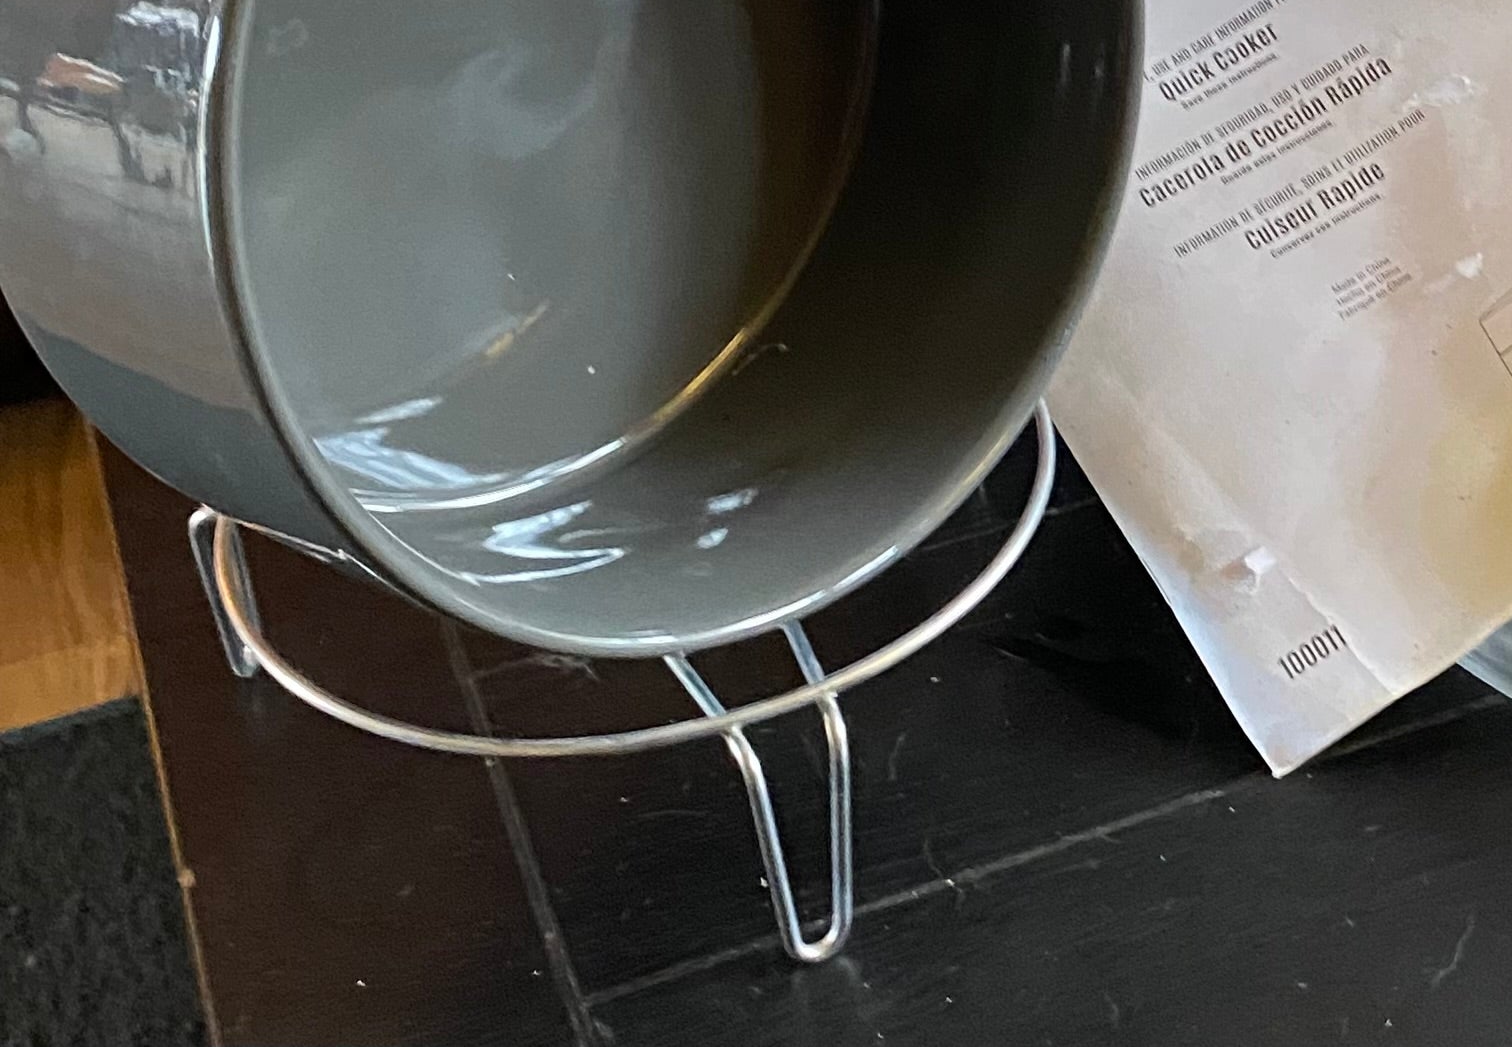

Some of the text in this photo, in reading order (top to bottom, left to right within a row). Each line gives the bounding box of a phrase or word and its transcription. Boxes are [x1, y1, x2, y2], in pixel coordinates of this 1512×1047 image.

[1153, 59, 1170, 77] USE
[1171, 47, 1191, 66] AND
[1191, 33, 1215, 54] CARE
[1159, 22, 1279, 102] Quick Cooker
[1202, 131, 1214, 145] DE
[1271, 88, 1293, 109] USO
[1291, 83, 1301, 96] Y
[1301, 59, 1343, 90] CUIDADO
[1342, 42, 1369, 65] PARA
[1140, 54, 1393, 210] Cacerola de Cocción Rápida
[1174, 214, 1239, 259] INFORMATION
[1239, 208, 1252, 223] DE
[1301, 164, 1332, 190] SOINS
[1331, 158, 1344, 173] ET
[1398, 108, 1426, 132] POUR
[1244, 159, 1386, 252] Cuiseur Rapide
[1278, 624, 1347, 680] 100011
